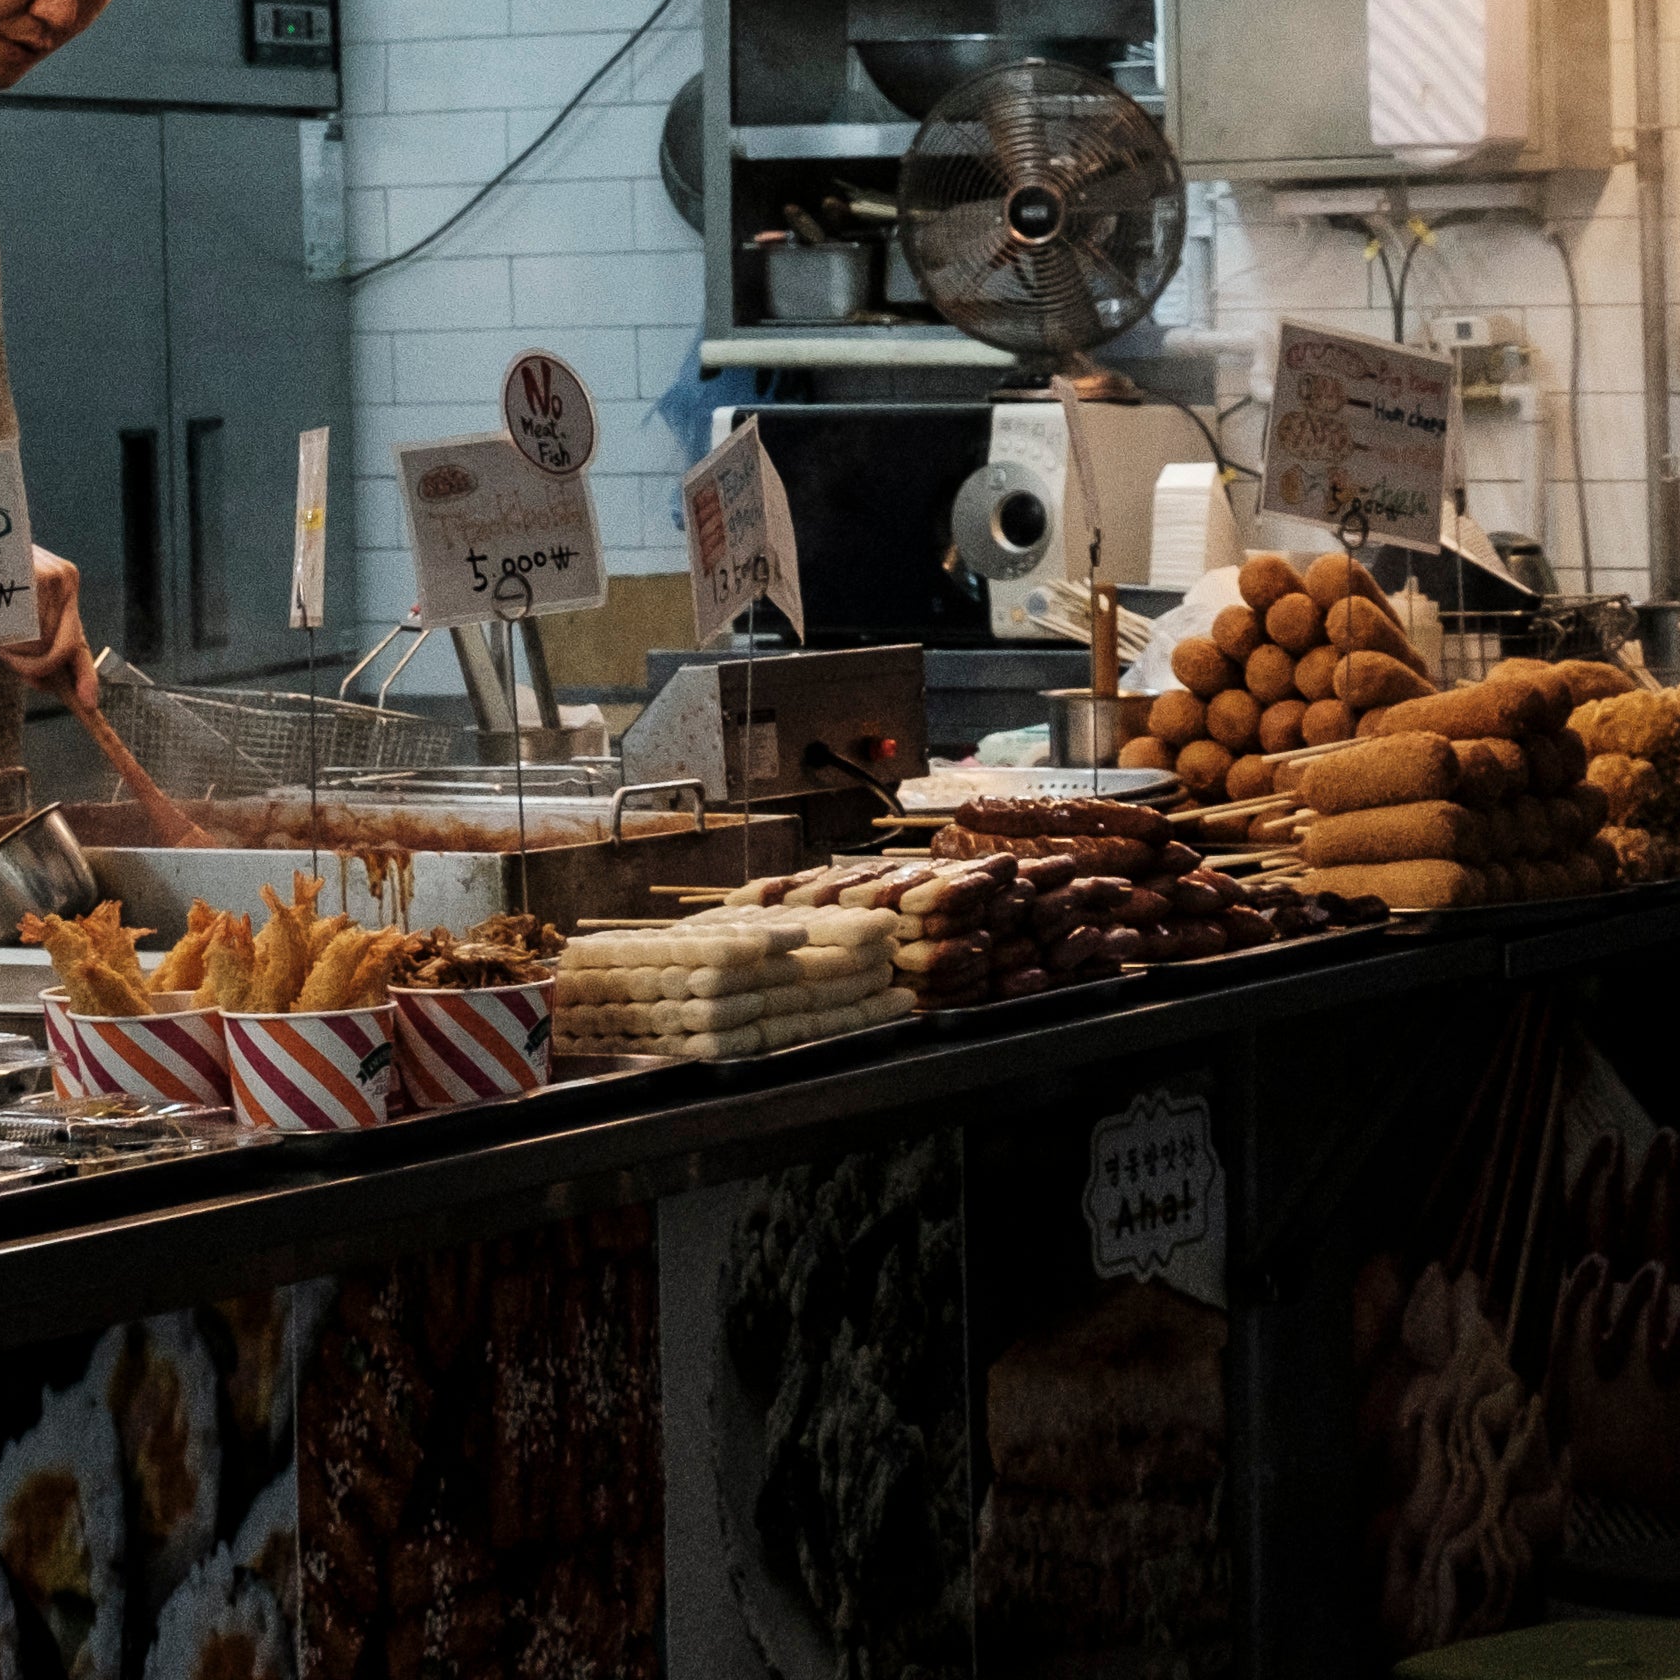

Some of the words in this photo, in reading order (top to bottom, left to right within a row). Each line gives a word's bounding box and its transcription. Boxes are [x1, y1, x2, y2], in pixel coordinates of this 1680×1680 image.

[521, 360, 563, 421] No
[538, 440, 571, 467] Fish
[1116, 1179, 1191, 1239] Aha!
